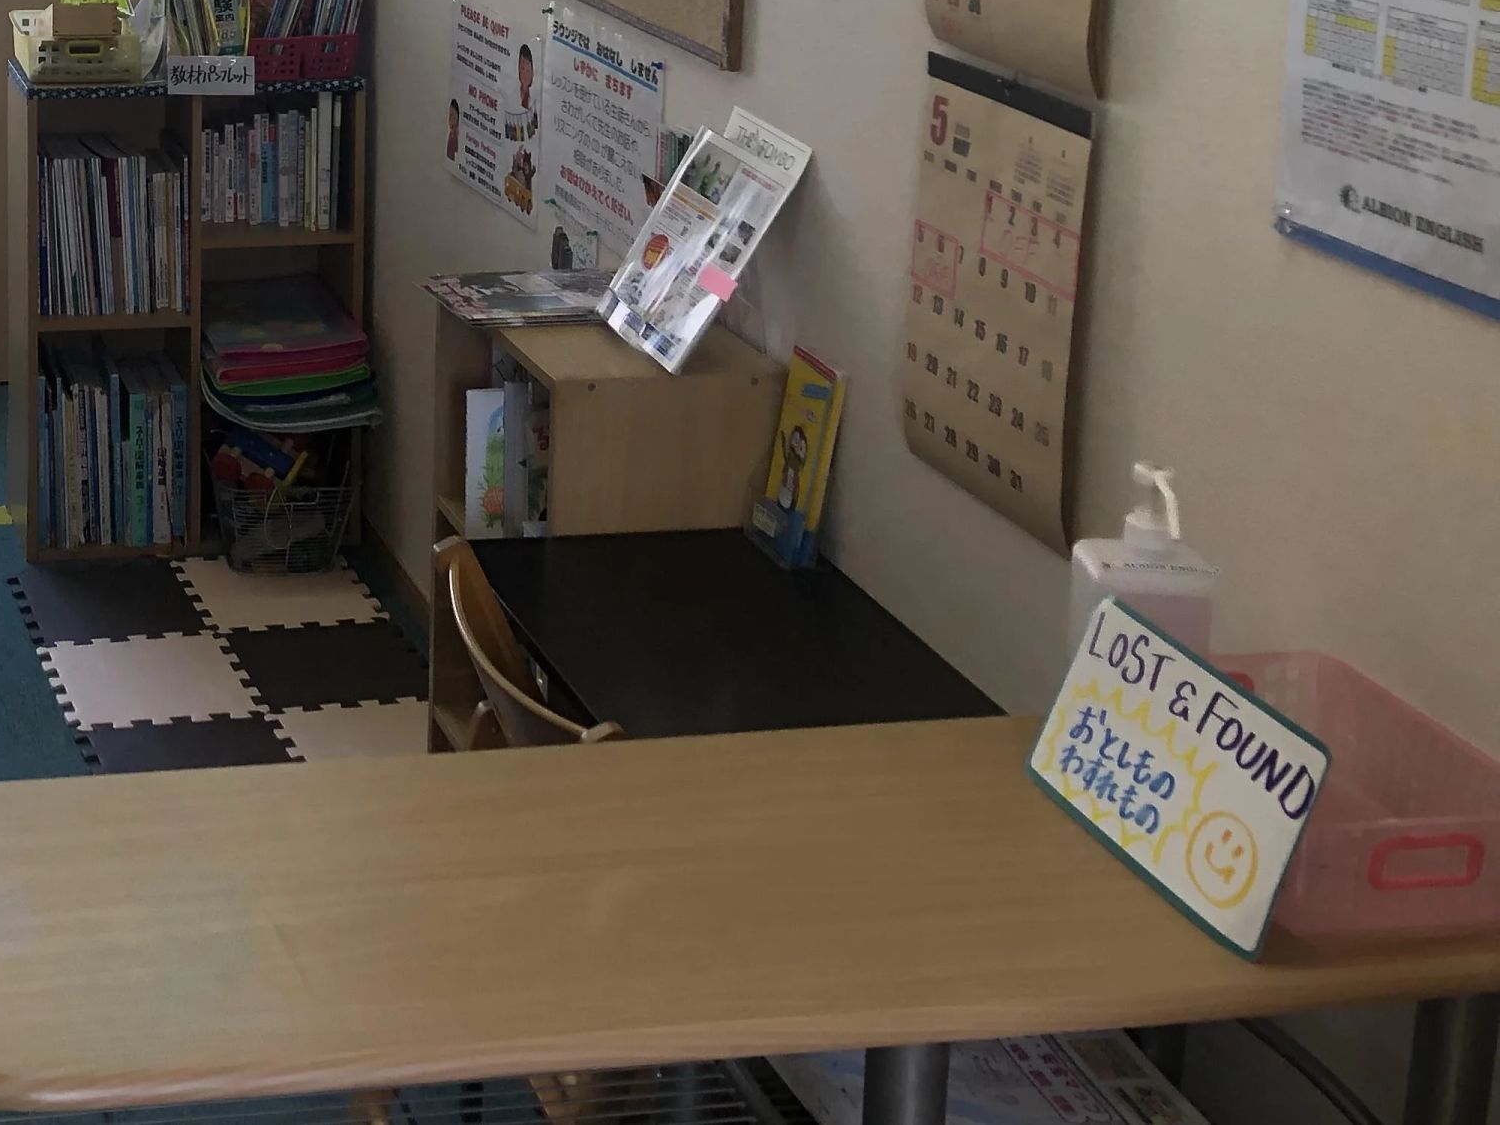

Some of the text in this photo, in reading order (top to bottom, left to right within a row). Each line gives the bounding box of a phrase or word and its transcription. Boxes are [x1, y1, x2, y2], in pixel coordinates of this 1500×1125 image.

[460, 4, 510, 39] PLEASE BE QUIET
[553, 20, 590, 50] ラウンジでは
[630, 58, 658, 85] しません
[170, 64, 252, 86] 教材パンフレット
[468, 83, 498, 112] NO PHONE
[605, 74, 634, 100] まちます
[930, 94, 948, 146] 5
[1362, 195, 1484, 254] ALBION ENGLISH
[912, 284, 923, 304] 12
[933, 294, 944, 315] 13
[954, 307, 964, 328] 14
[974, 319, 986, 341] 15
[996, 333, 1008, 355] 16
[1018, 346, 1029, 367] 17
[907, 342, 1049, 447] 19 20 21 22 23 24 25
[1089, 612, 1315, 820] LOST & FOUND
[1069, 706, 1176, 800] おとしもの
[1060, 745, 1160, 834] わすれもの
